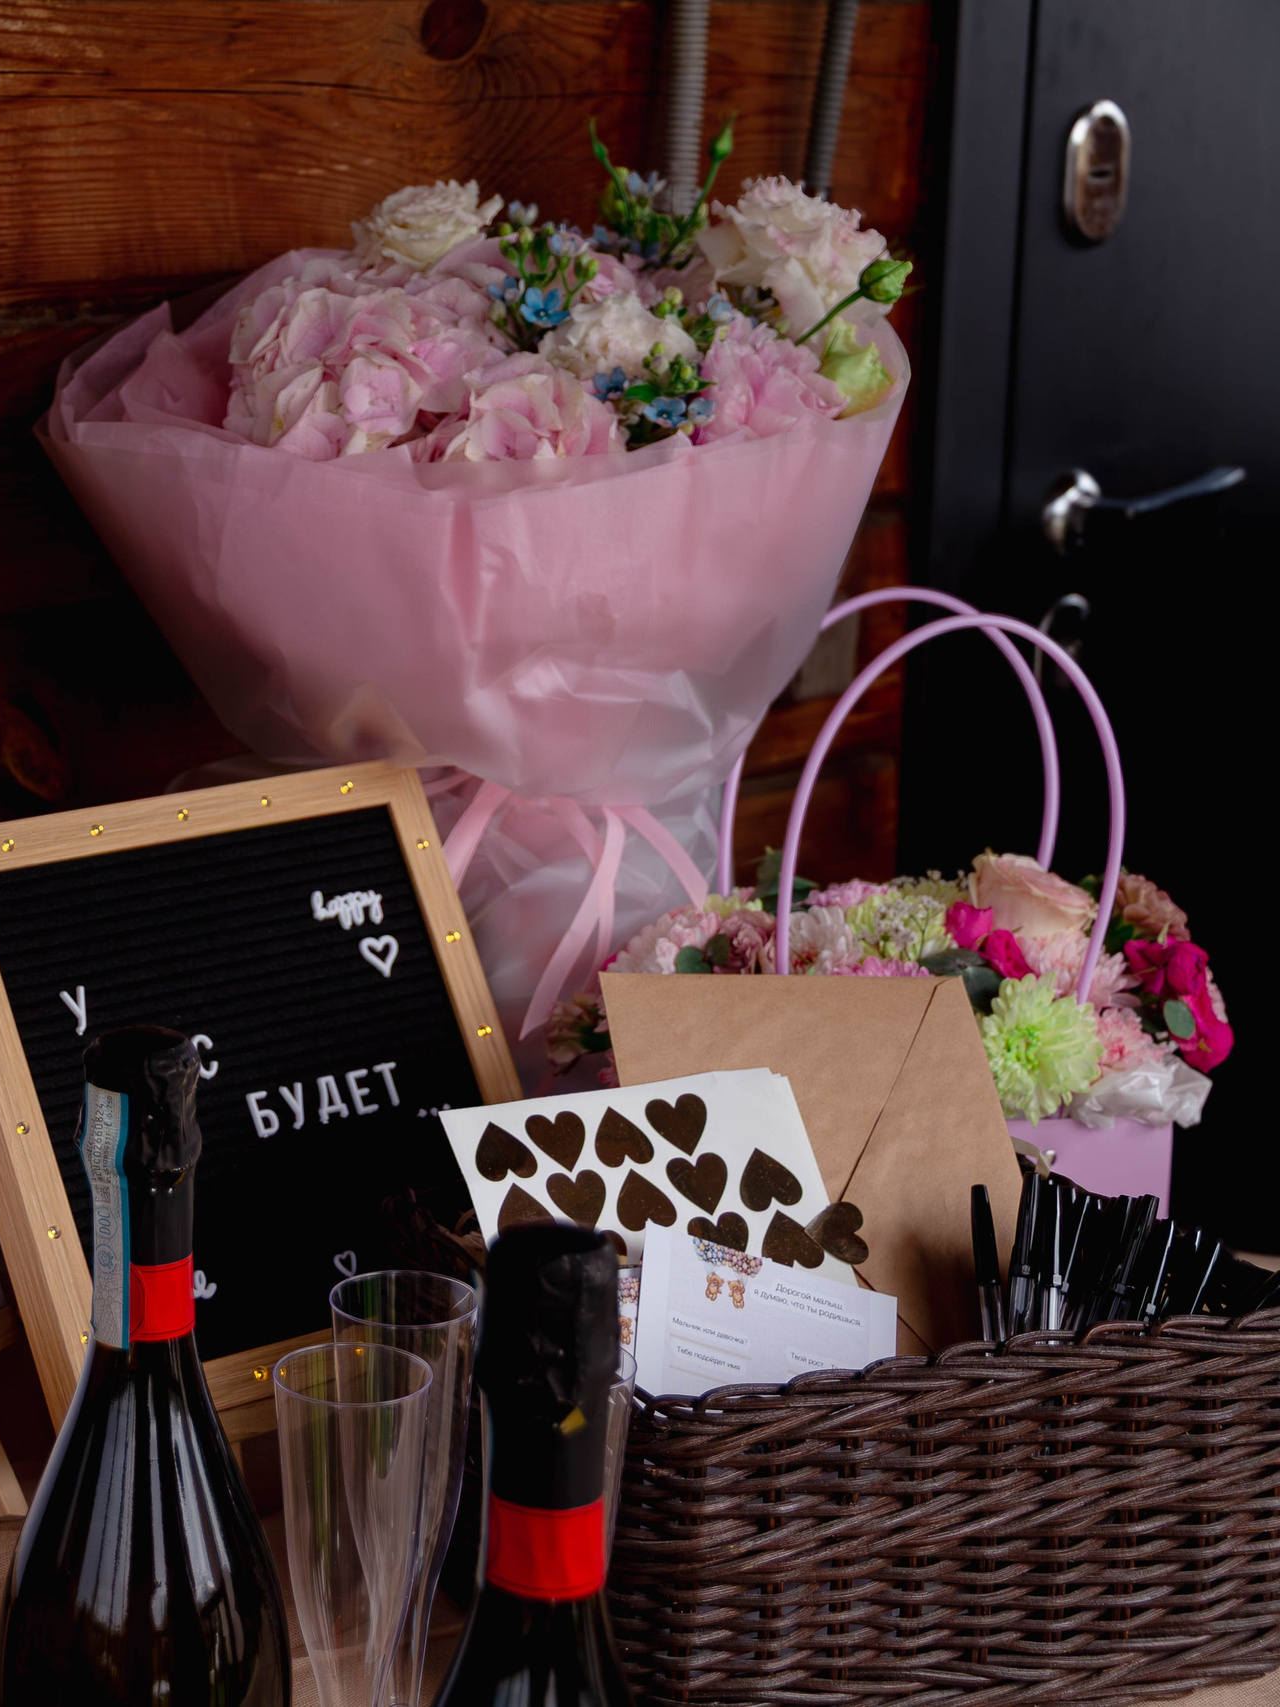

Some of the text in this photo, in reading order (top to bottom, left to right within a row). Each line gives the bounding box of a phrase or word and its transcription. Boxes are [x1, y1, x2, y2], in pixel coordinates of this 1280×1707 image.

[310, 889, 384, 930] happy
[98, 1209, 111, 1236] DOC
[753, 1288, 759, 1296] я
[760, 1291, 789, 1306] думаю,
[791, 1301, 805, 1310] что
[807, 1305, 818, 1314] ты
[775, 1283, 812, 1302] Дорогой
[672, 1316, 702, 1332] Мальчик
[703, 1327, 716, 1336] или
[676, 1345, 693, 1357] Тебе
[727, 1362, 741, 1371] имя
[791, 1352, 807, 1363] Твой
[808, 1359, 824, 1369] рост
